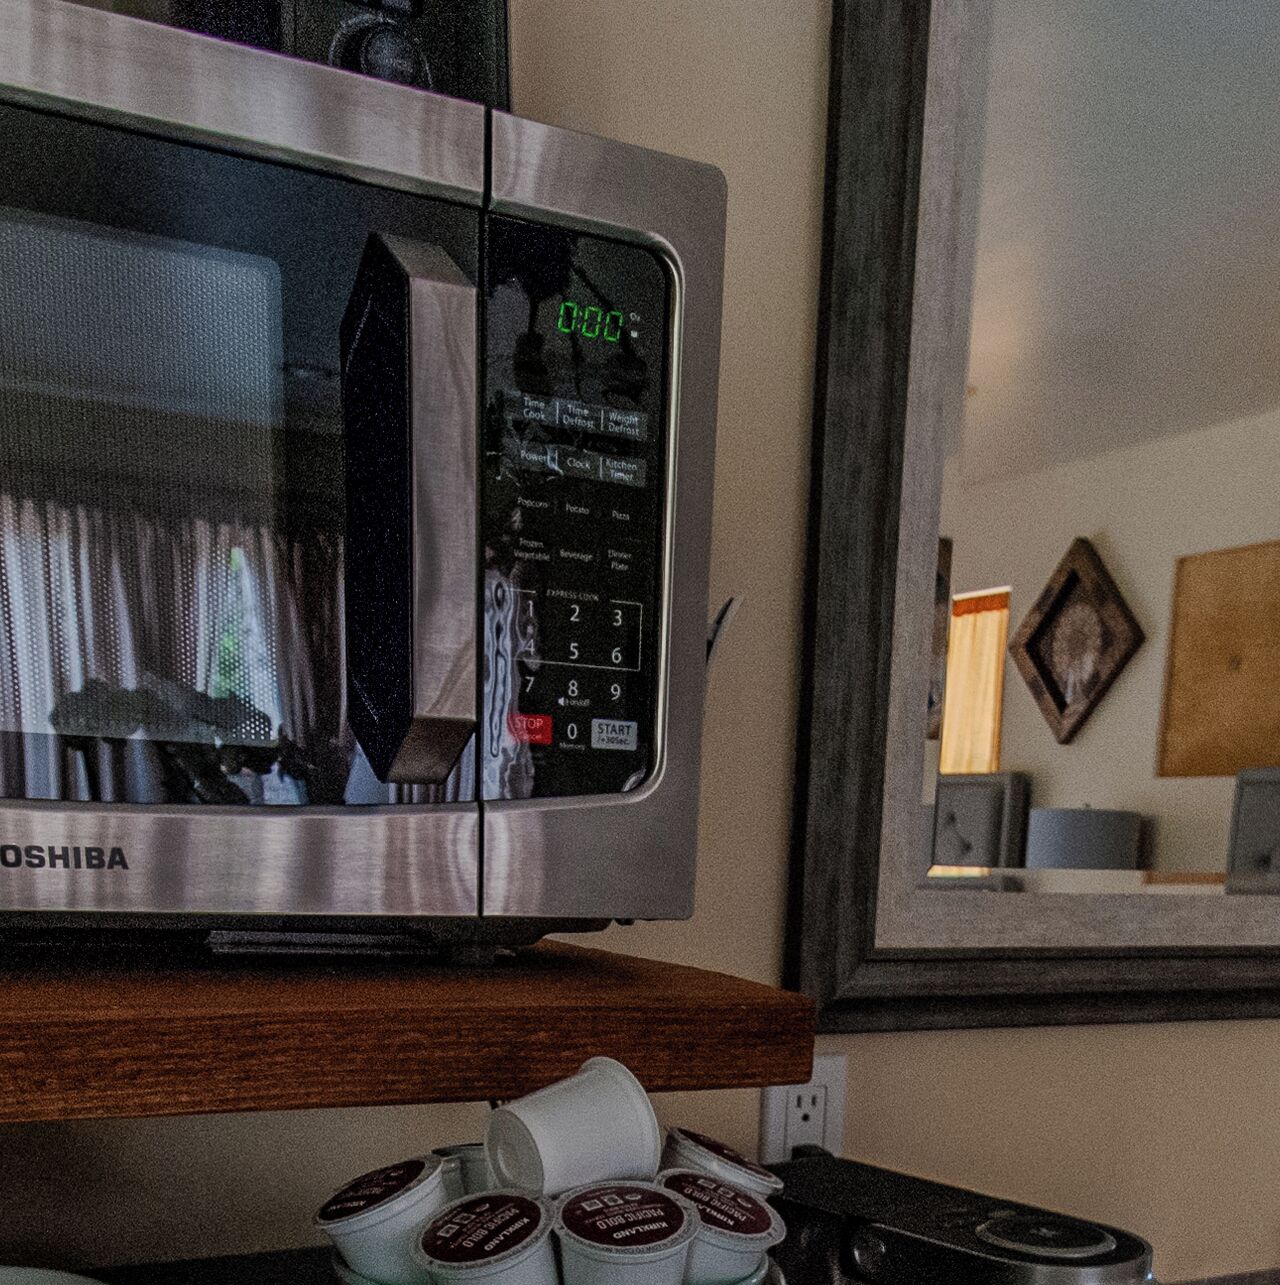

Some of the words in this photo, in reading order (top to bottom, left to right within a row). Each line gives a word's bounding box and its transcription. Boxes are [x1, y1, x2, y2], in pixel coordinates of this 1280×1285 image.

[523, 396, 545, 409] Time
[567, 404, 590, 416] Time
[523, 408, 545, 420] Cook
[563, 414, 595, 429] Defrost
[608, 411, 639, 426] Weight
[608, 421, 640, 436] Defrost
[566, 457, 591, 470] Clock
[605, 458, 638, 472] Kitchen
[517, 496, 549, 509] Popcorn
[527, 600, 535, 617] 1
[569, 603, 581, 622] 2
[611, 608, 623, 627] 3
[524, 638, 536, 657] 4
[568, 641, 580, 660] 5
[610, 646, 623, 664] 6
[525, 675, 535, 693] 7
[567, 679, 579, 697] 8
[609, 682, 622, 701] 9
[515, 716, 544, 729] STOP
[566, 722, 578, 740] 0
[597, 722, 632, 736] START
[623, 1207, 665, 1223] PACIFIC
[709, 1196, 747, 1222] PACIFIC
[482, 1206, 520, 1231] PACIFIC
[595, 1214, 627, 1231] BOLD
[483, 1216, 531, 1252] KIRKLAND
[612, 1220, 669, 1240] KIRKLAND
